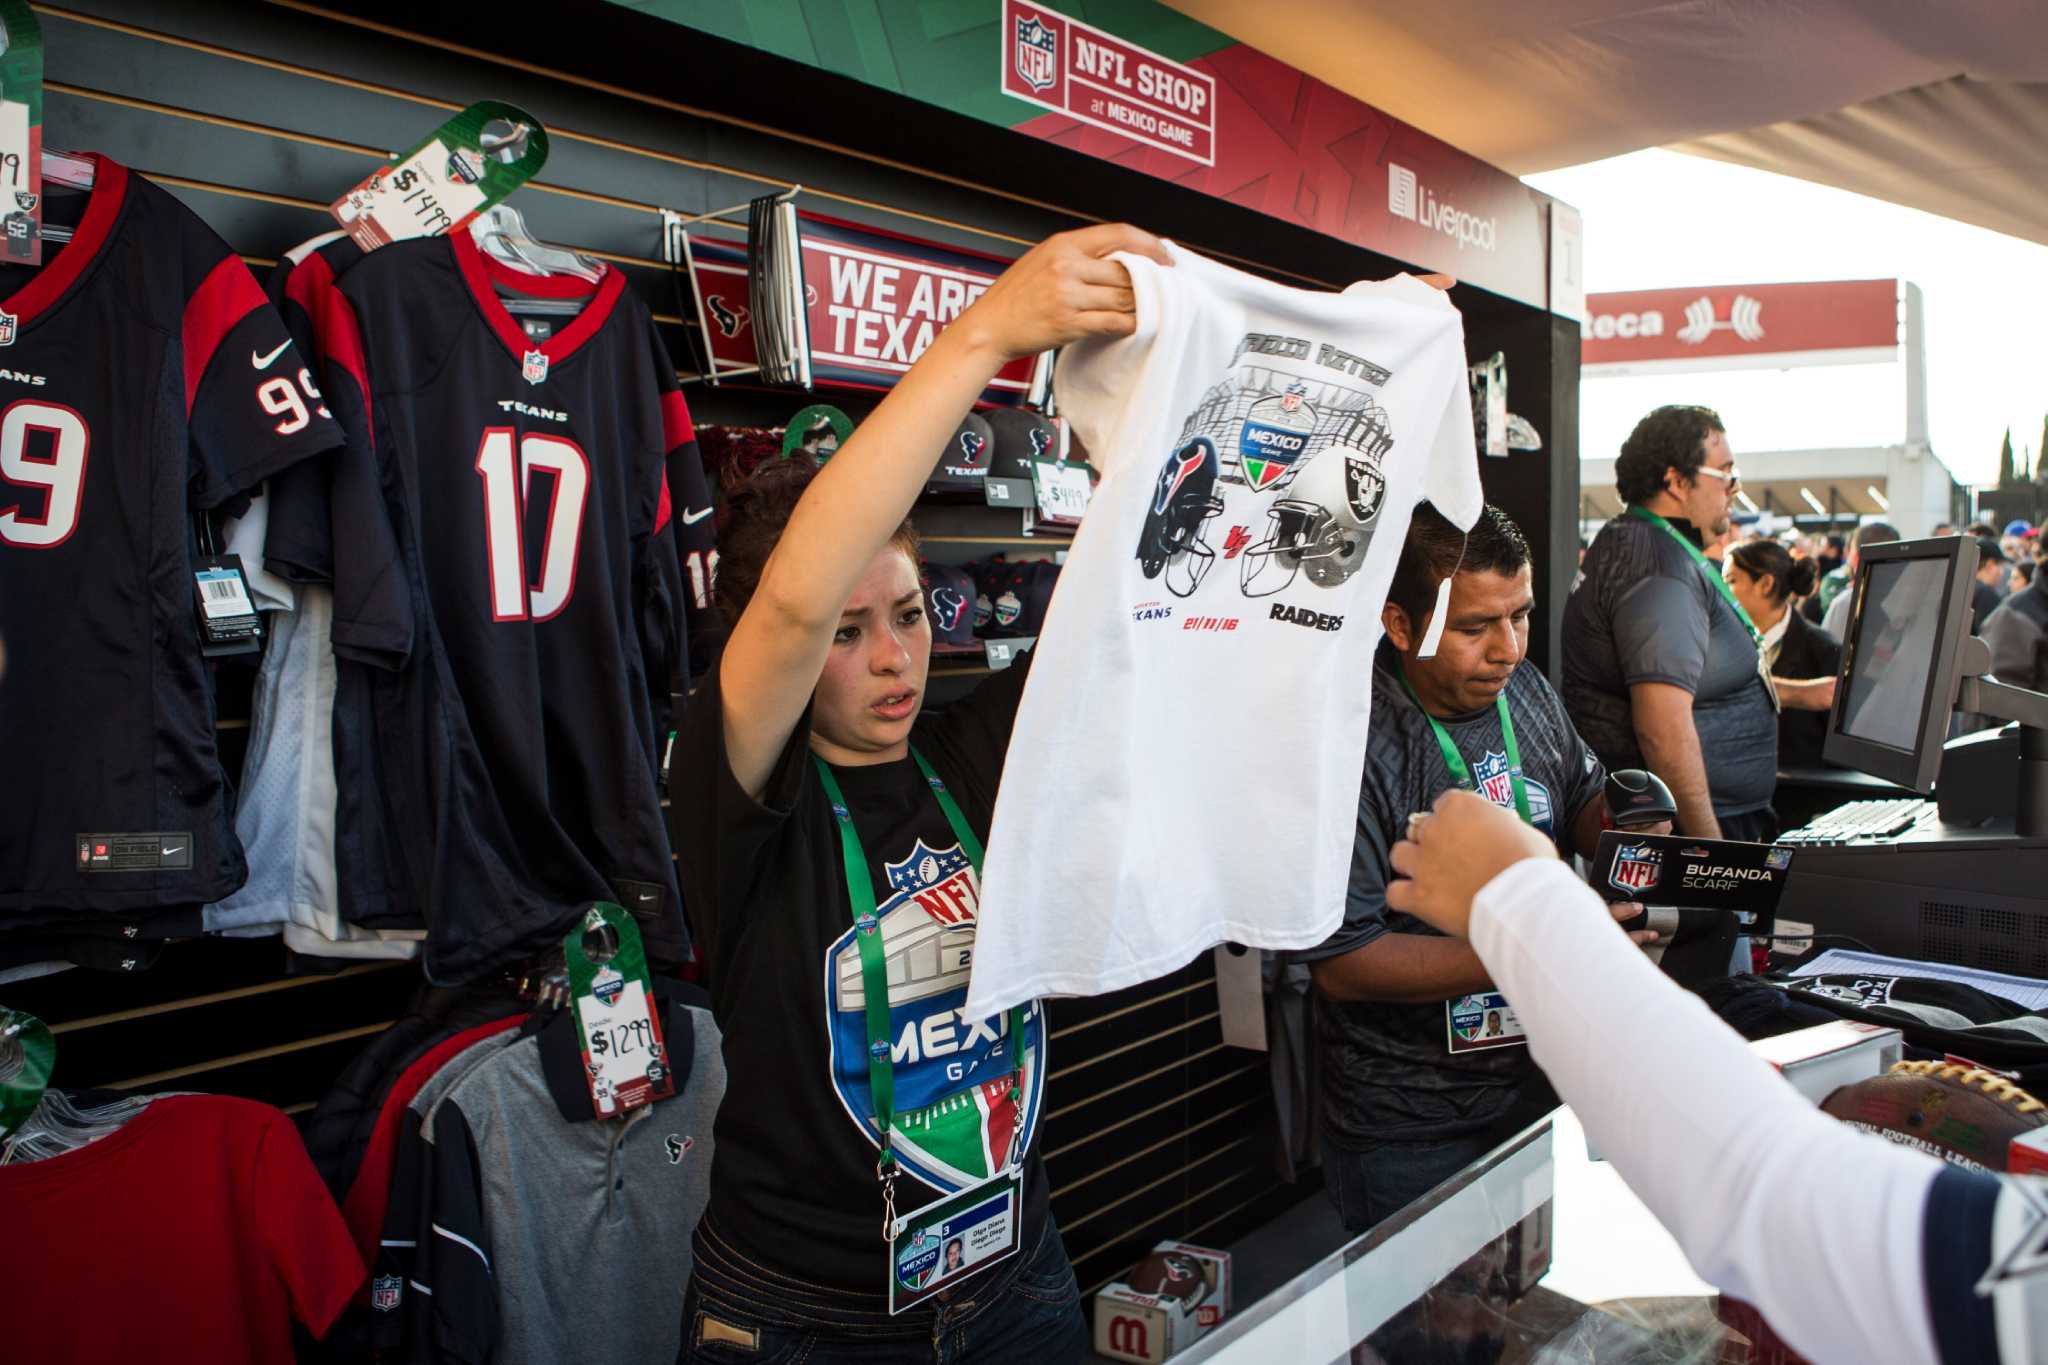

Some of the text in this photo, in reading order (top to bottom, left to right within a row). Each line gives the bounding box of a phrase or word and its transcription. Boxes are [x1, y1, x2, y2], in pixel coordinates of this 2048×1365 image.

[1019, 42, 1053, 83] NFL
[1075, 36, 1206, 115] NFL SHOP
[1090, 98, 1194, 147] at MEXICO GAME
[7, 221, 28, 239] 52
[1419, 185, 1496, 252] Liverpool
[829, 256, 900, 314] WE
[828, 304, 949, 364] TEXA
[1247, 427, 1303, 451] MEXICO
[474, 426, 592, 624] 10
[1183, 616, 1240, 631] 21/11/16
[1268, 602, 1345, 632] RAIDERS
[1486, 775, 1511, 802] NFL
[1617, 861, 1658, 888] NFL
[1682, 876, 1740, 891] SCARF
[1685, 864, 1773, 882] BUFANDA
[1456, 1015, 1480, 1024] MEXICO
[591, 1018, 656, 1058] $1299
[1882, 1127, 1942, 1157] FOOTBALL
[943, 1225, 950, 1235] 3
[902, 1251, 936, 1273] MEXICO
[376, 1289, 398, 1306] NFL
